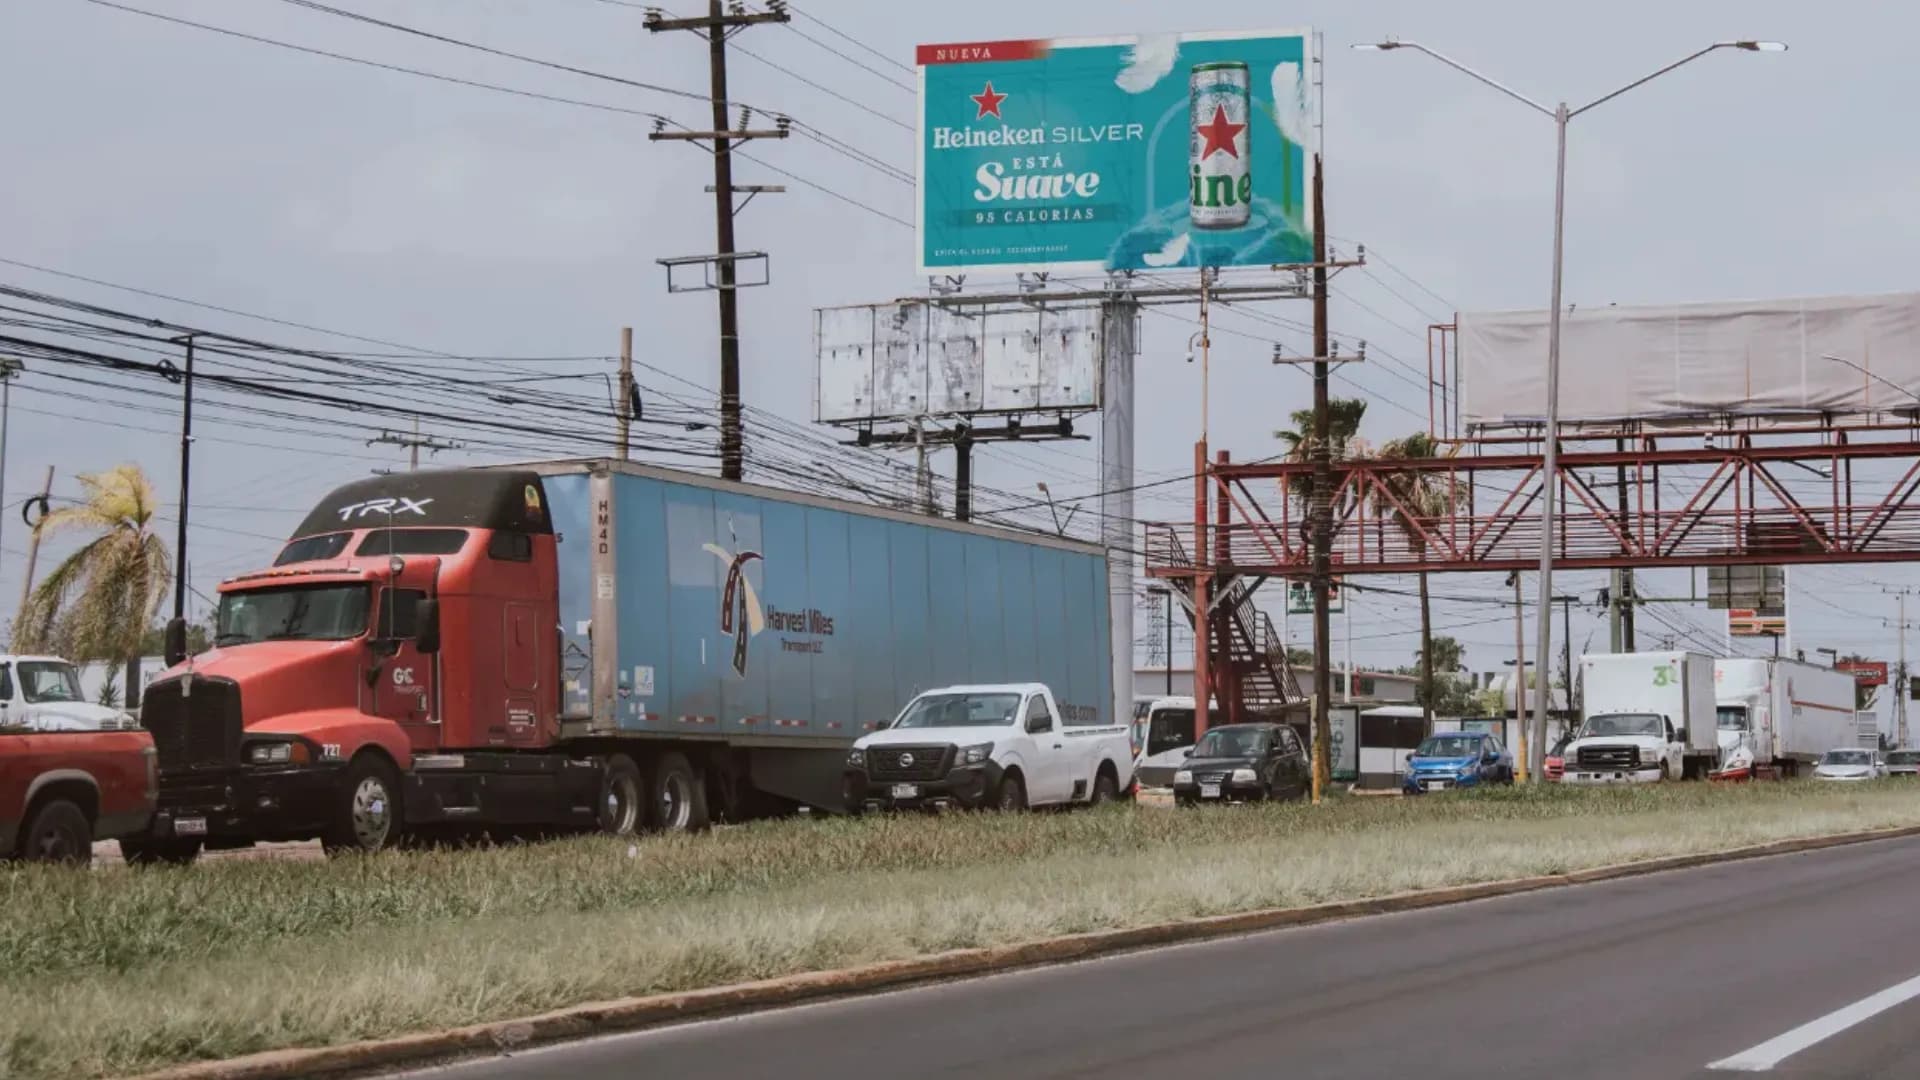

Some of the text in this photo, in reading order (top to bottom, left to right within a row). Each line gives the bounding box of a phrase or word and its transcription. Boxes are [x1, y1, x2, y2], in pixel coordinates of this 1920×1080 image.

[936, 48, 993, 61] NUEVA
[933, 123, 1144, 149] Heineken SILVER
[1012, 152, 1063, 170] ESTÁ
[974, 161, 1100, 202] Suave
[975, 206, 1095, 224] 95 CALORÍAS
[337, 496, 434, 521] TRX
[767, 604, 807, 632] Harvest
[392, 667, 414, 685] GC
[322, 743, 341, 759] 727
